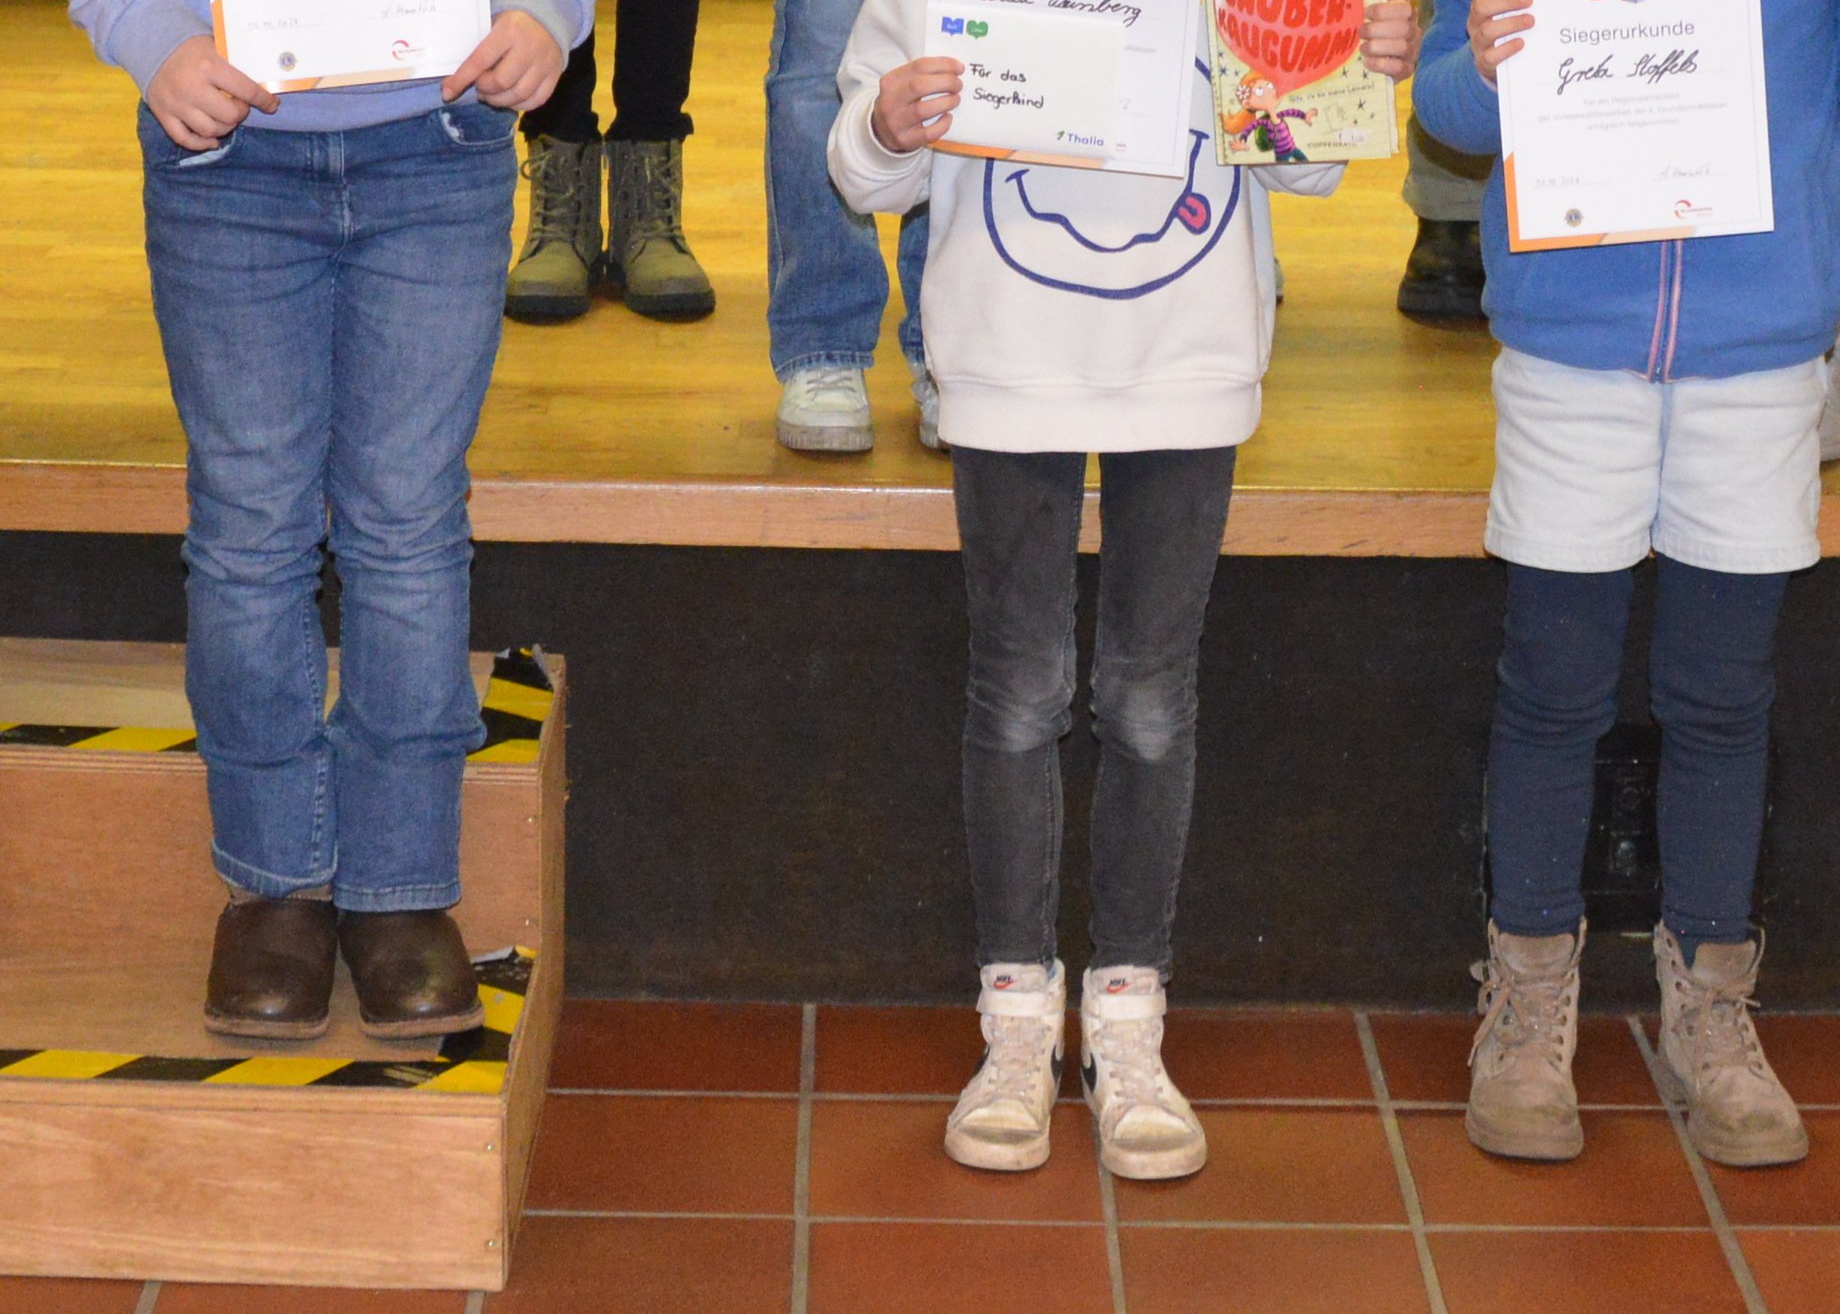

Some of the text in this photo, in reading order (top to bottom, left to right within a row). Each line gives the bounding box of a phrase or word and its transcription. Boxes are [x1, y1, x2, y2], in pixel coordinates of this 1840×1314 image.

[1558, 21, 1696, 46] Siegerurkunde
[969, 62, 1027, 83] Für das
[1556, 49, 1700, 95] Greta Stoffels
[972, 87, 1044, 110] Siegerkind
[1066, 133, 1105, 147] Thalia
